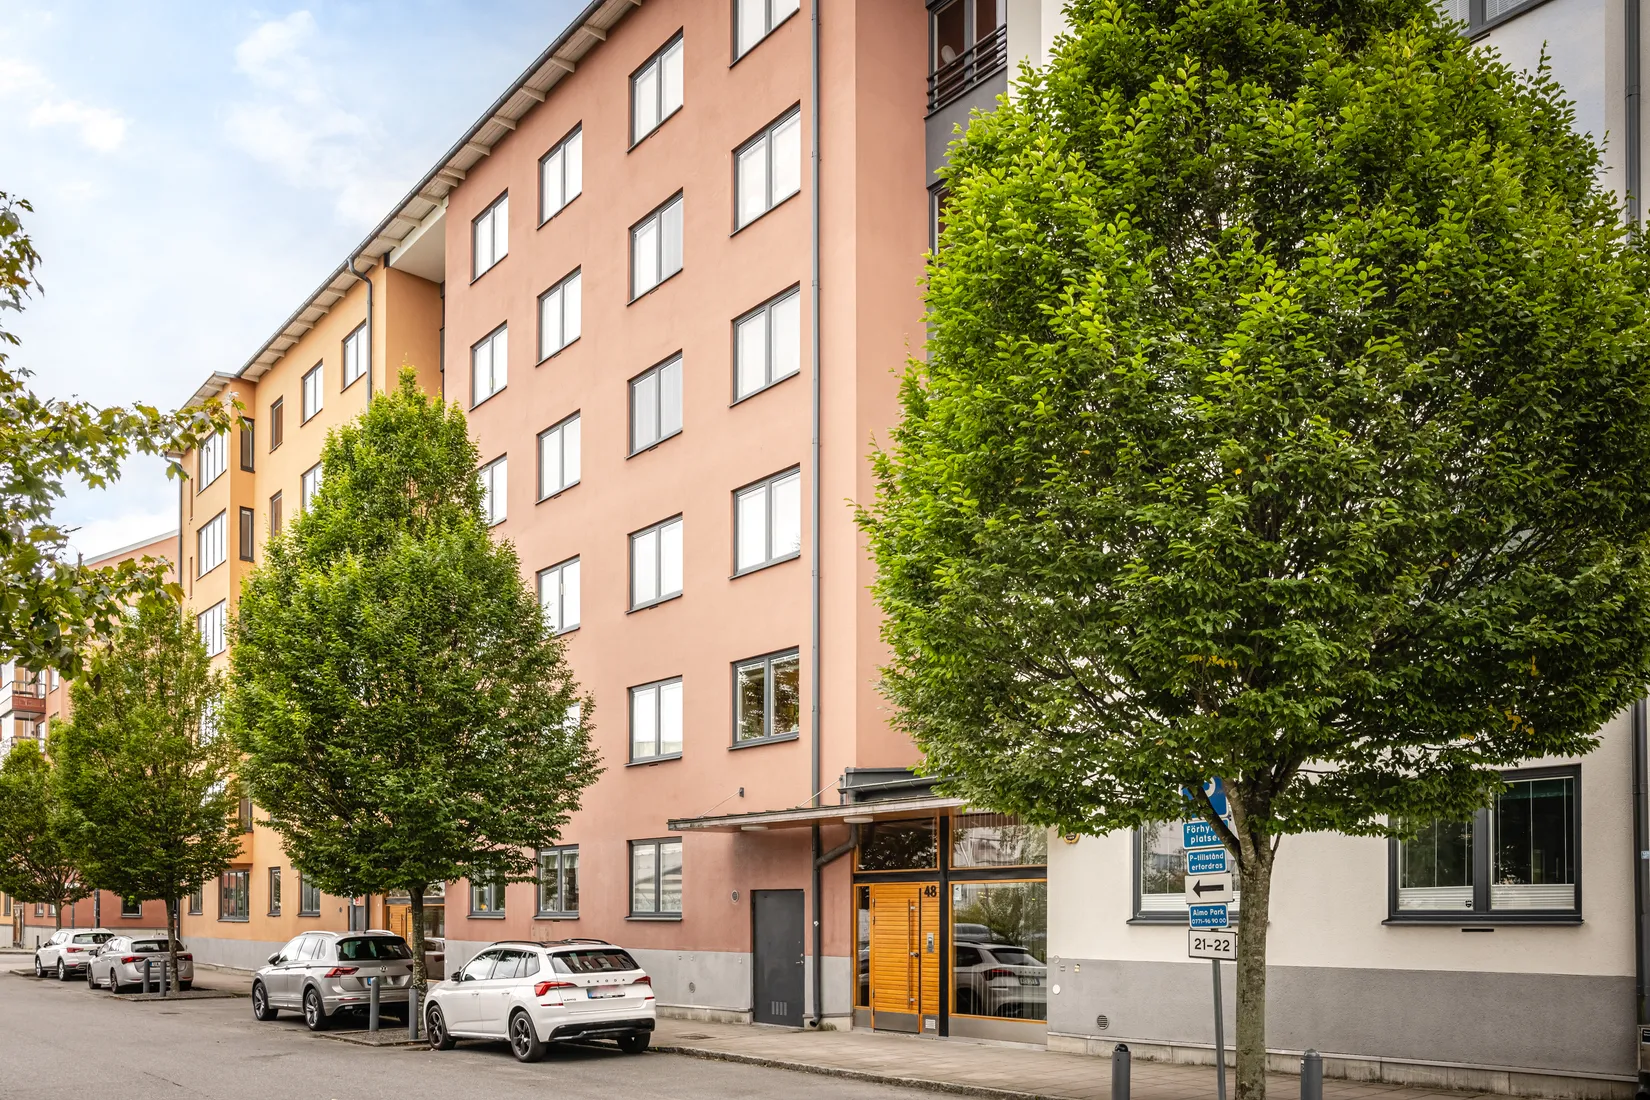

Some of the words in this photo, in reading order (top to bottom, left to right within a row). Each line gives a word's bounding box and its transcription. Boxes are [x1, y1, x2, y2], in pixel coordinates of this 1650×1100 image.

[1189, 852, 1224, 861] P-tillstånd
[924, 885, 937, 898] 48
[1209, 908, 1225, 916] Park
[1194, 937, 1230, 952] 21-22
